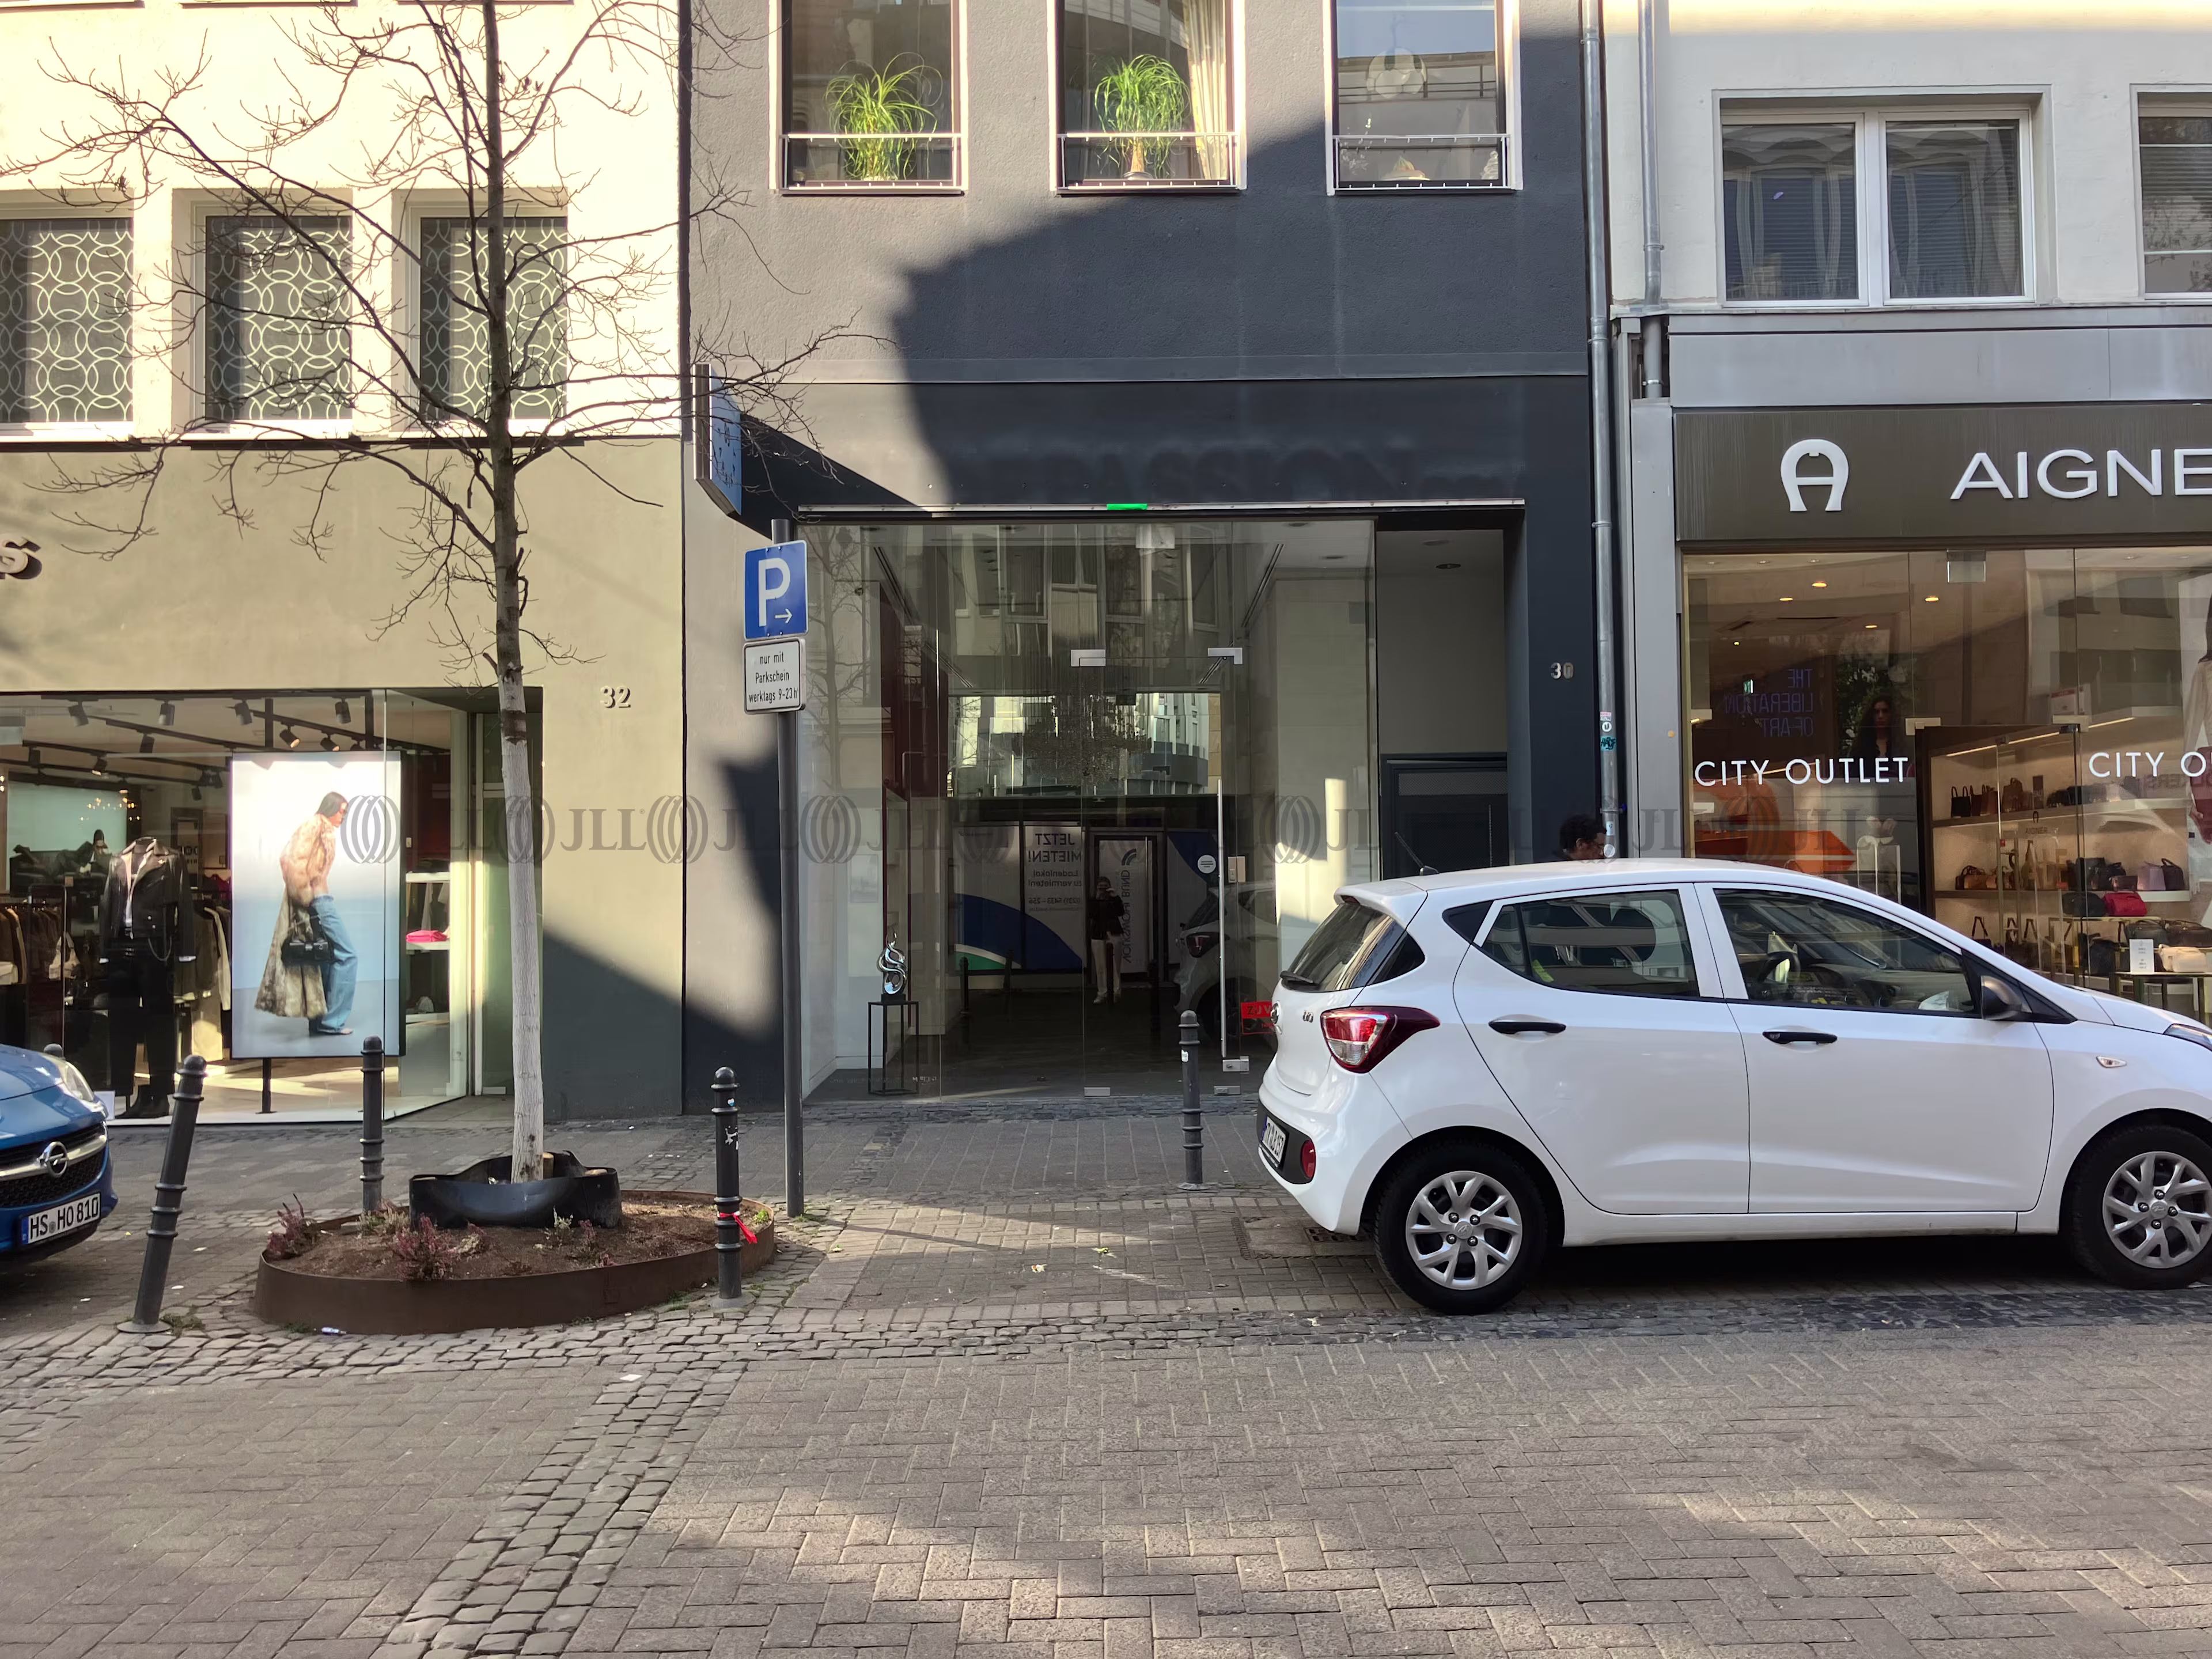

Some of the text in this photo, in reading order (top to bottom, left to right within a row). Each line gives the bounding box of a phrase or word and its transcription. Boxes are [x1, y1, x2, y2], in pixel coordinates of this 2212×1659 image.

[1950, 449, 2212, 500] AIGNE
[758, 557, 791, 627] P
[760, 651, 784, 665] nur mit
[755, 669, 789, 684] Parkschein
[1550, 662, 1574, 680] 30
[600, 685, 631, 709] 32
[749, 690, 775, 704] werktags
[1694, 757, 1908, 787] CITY OUTLET
[2089, 751, 2212, 778] CITY O
[31, 1197, 99, 1240] HS HO 810
